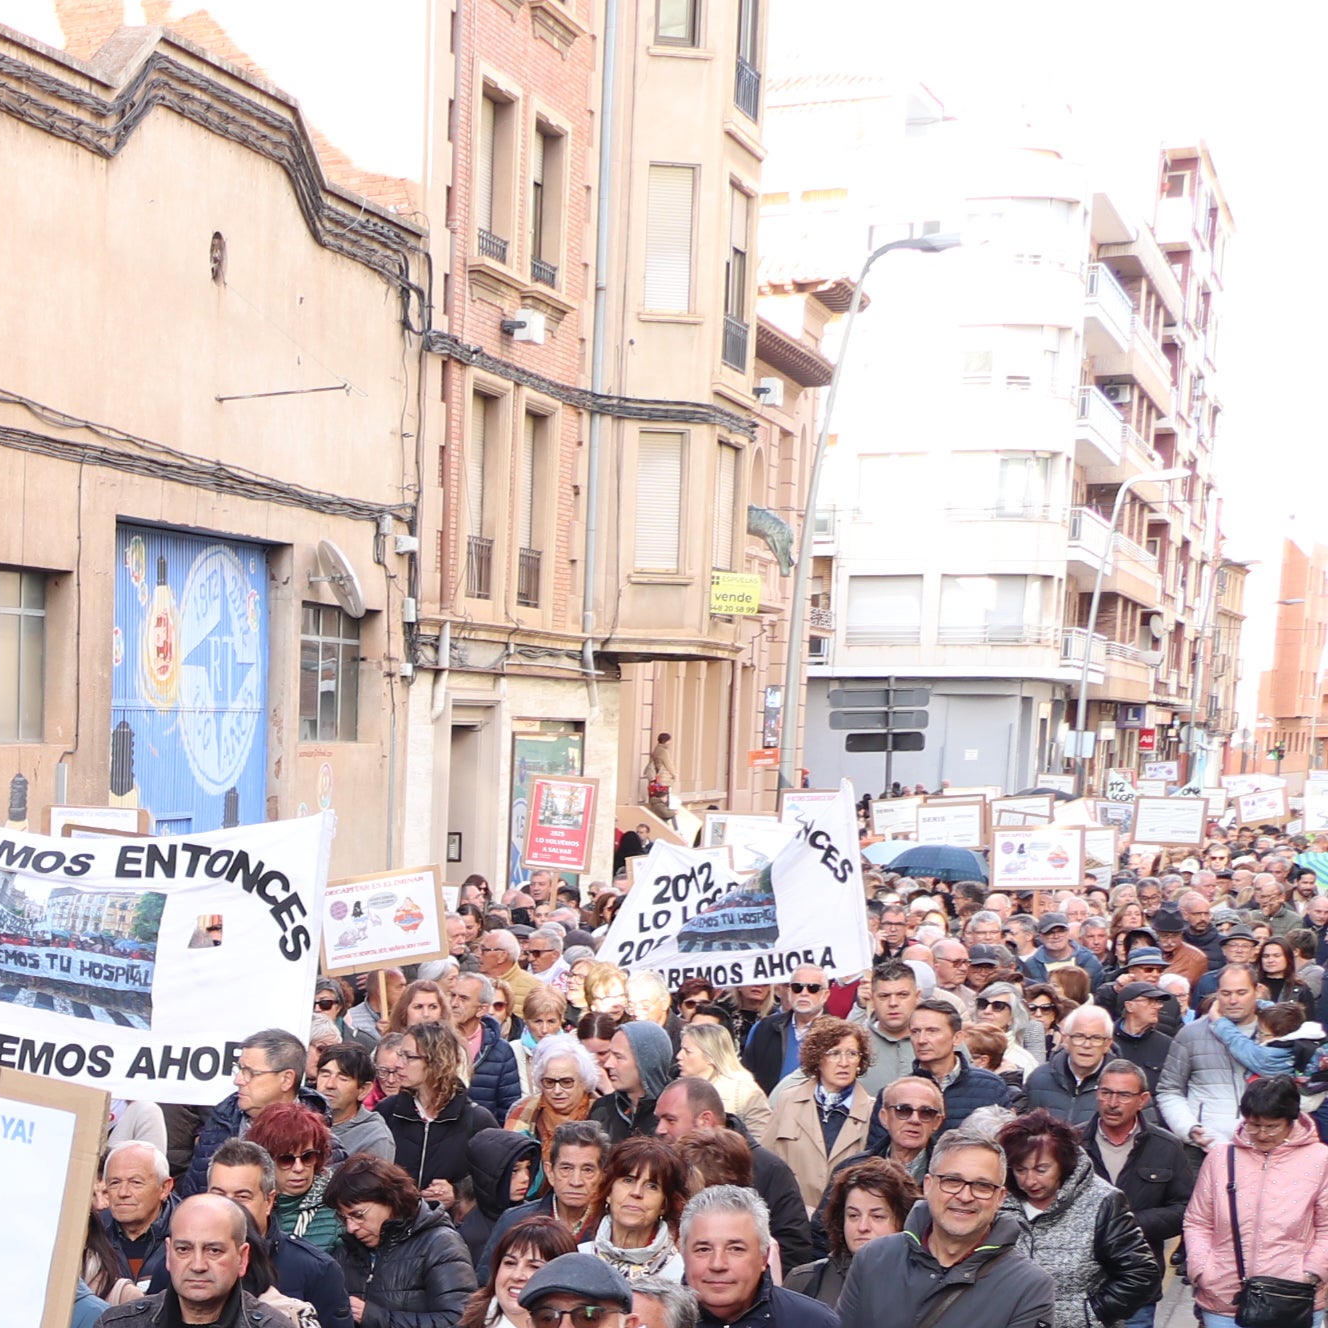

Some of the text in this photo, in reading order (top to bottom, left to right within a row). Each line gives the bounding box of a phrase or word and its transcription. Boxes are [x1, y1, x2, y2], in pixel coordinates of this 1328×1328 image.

[714, 593, 752, 603] vende
[545, 838, 580, 847] VOLVEMOS
[325, 885, 369, 896] DECAPITAR
[652, 861, 715, 905] 2012
[115, 843, 311, 962] ENTONCES
[639, 910, 671, 933] LO
[46, 952, 71, 973] TU
[80, 959, 153, 986] HOSPITAL
[0, 1114, 35, 1145] YA!
